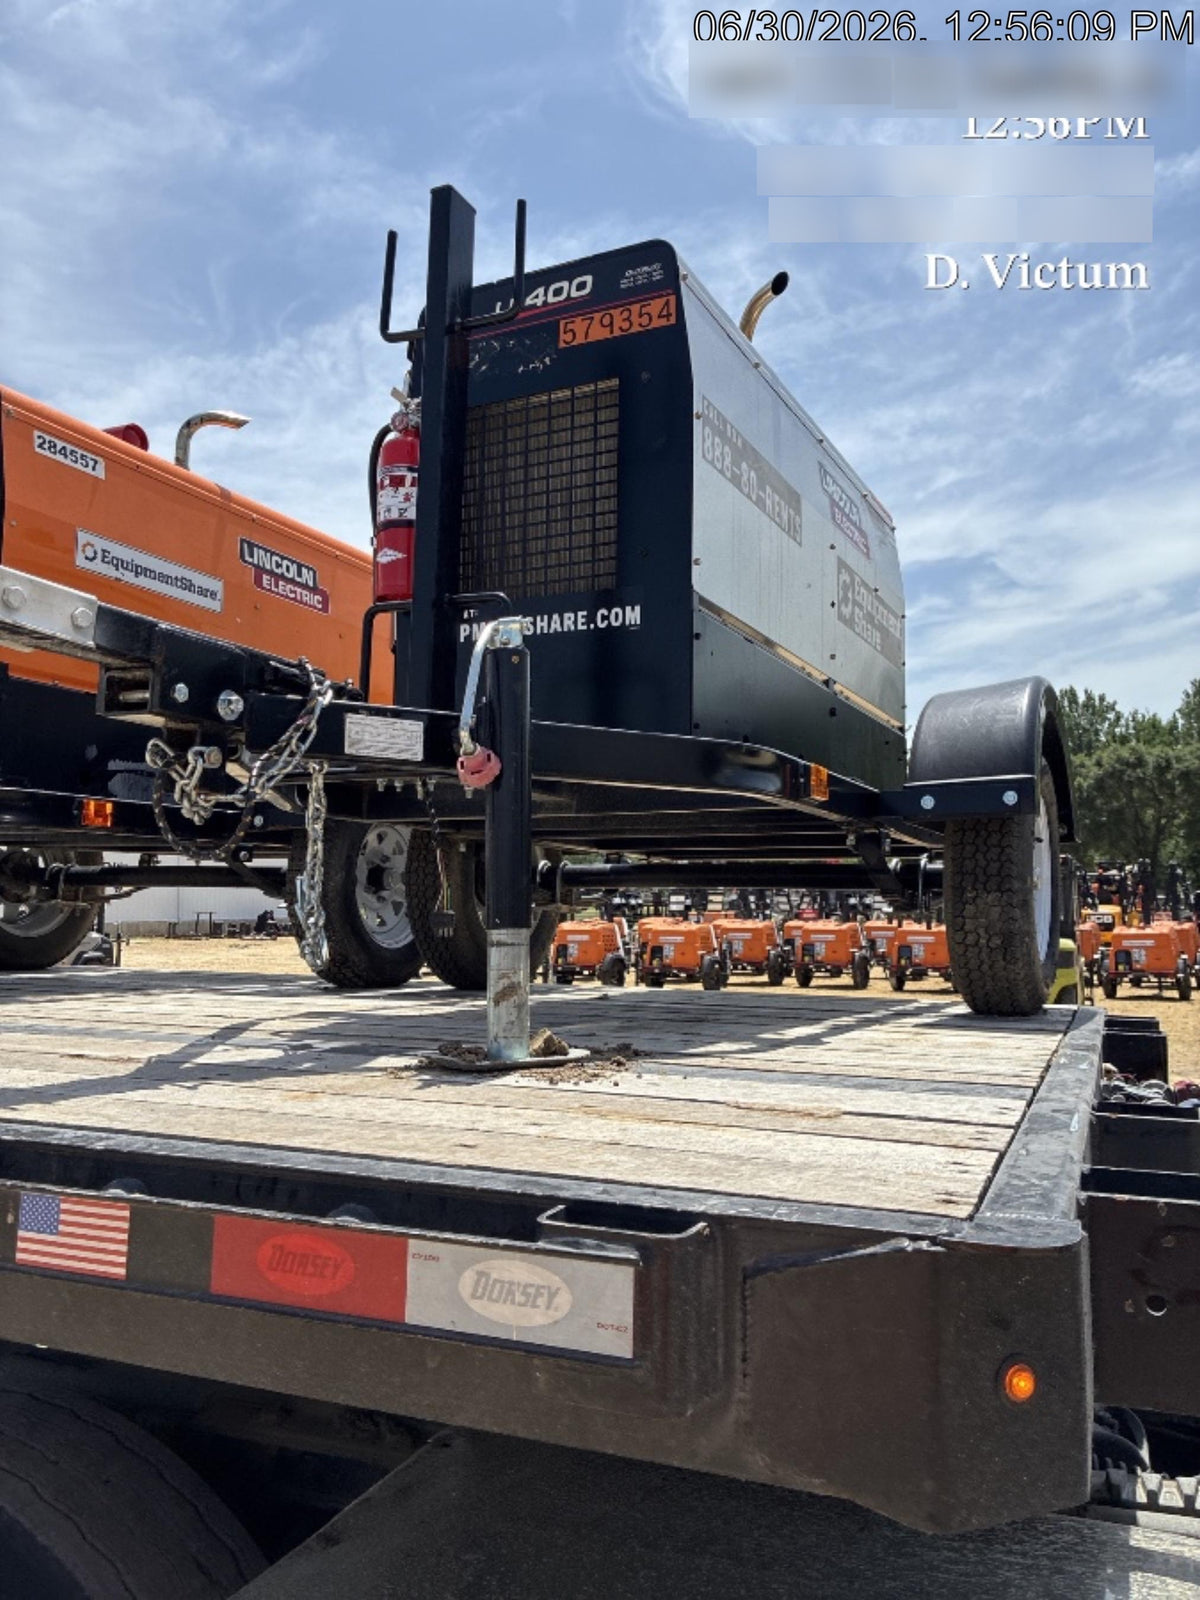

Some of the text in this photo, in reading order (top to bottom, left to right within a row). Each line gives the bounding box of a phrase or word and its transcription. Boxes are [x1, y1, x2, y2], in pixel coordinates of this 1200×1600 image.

[524, 274, 593, 307] 400
[562, 298, 673, 346] 579354
[36, 434, 99, 472] 284557
[241, 541, 314, 587] LINCOLN
[261, 573, 323, 609] ELECTRIC
[267, 1244, 343, 1281] DORSEY
